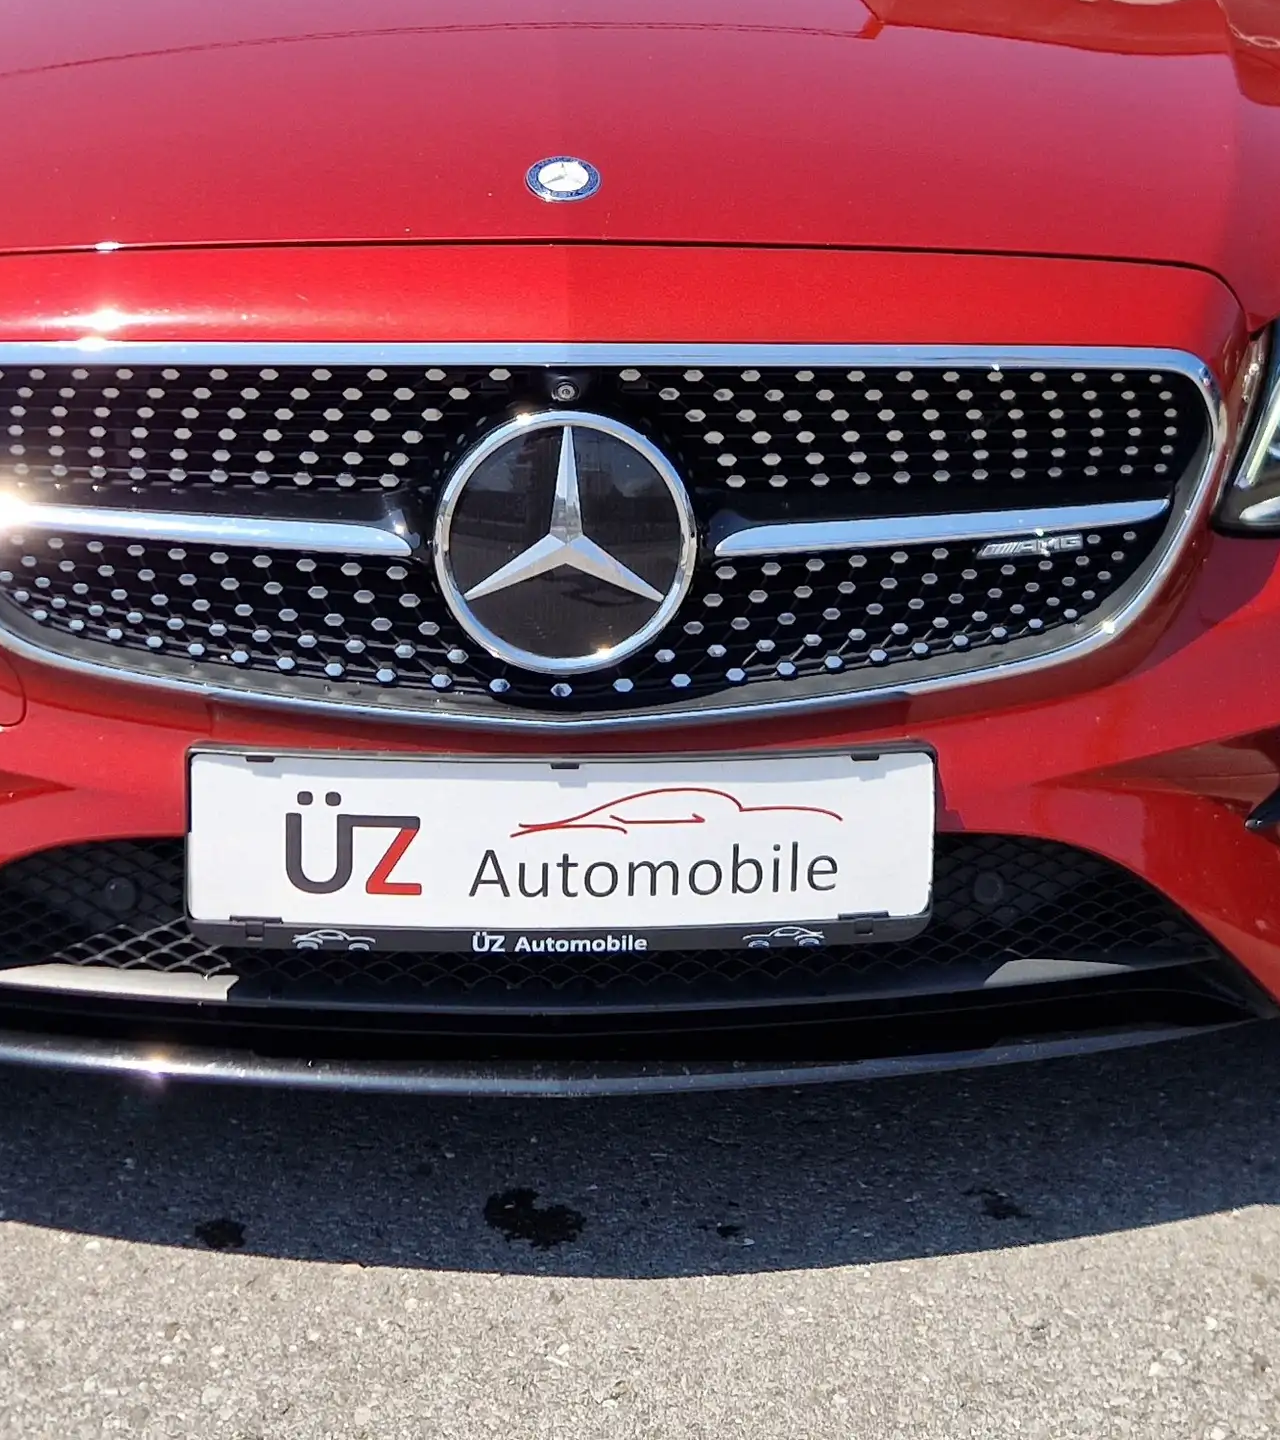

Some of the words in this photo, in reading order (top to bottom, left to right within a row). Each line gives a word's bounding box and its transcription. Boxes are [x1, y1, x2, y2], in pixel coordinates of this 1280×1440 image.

[285, 790, 422, 896] ÜZ
[468, 841, 838, 898] Automobile
[472, 932, 506, 952] ÜZ
[515, 933, 648, 953] Automobile
